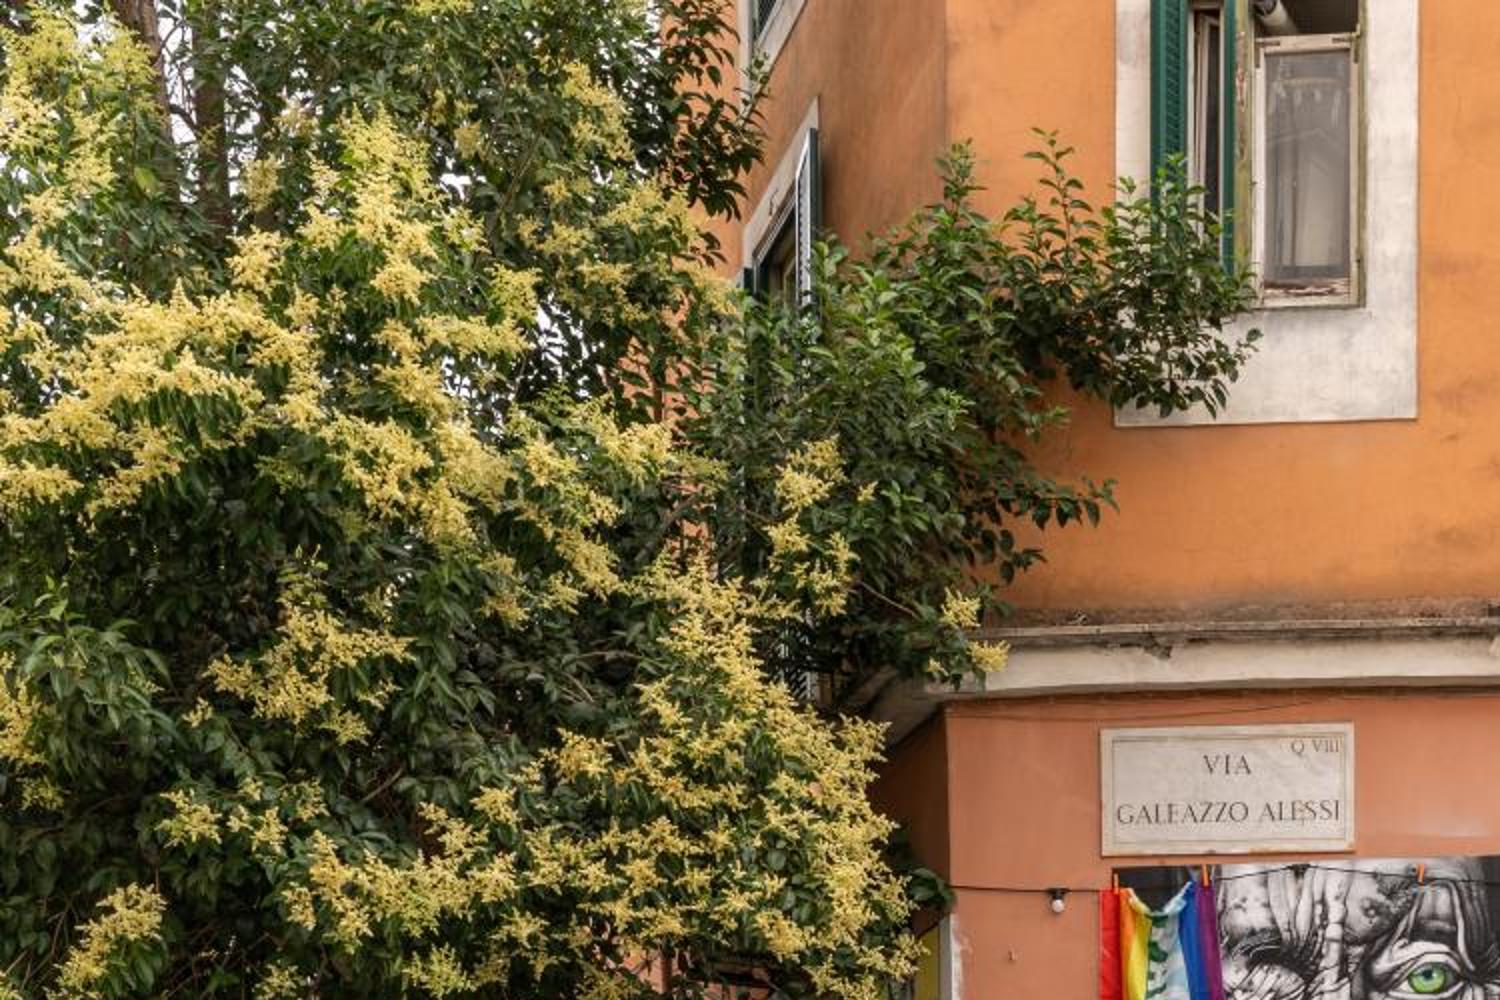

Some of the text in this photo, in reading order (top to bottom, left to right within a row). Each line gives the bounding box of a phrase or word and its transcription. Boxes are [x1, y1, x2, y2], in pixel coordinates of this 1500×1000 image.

[1202, 754, 1253, 776] VIA
[1116, 799, 1340, 825] GALEAZZO ALESSI
